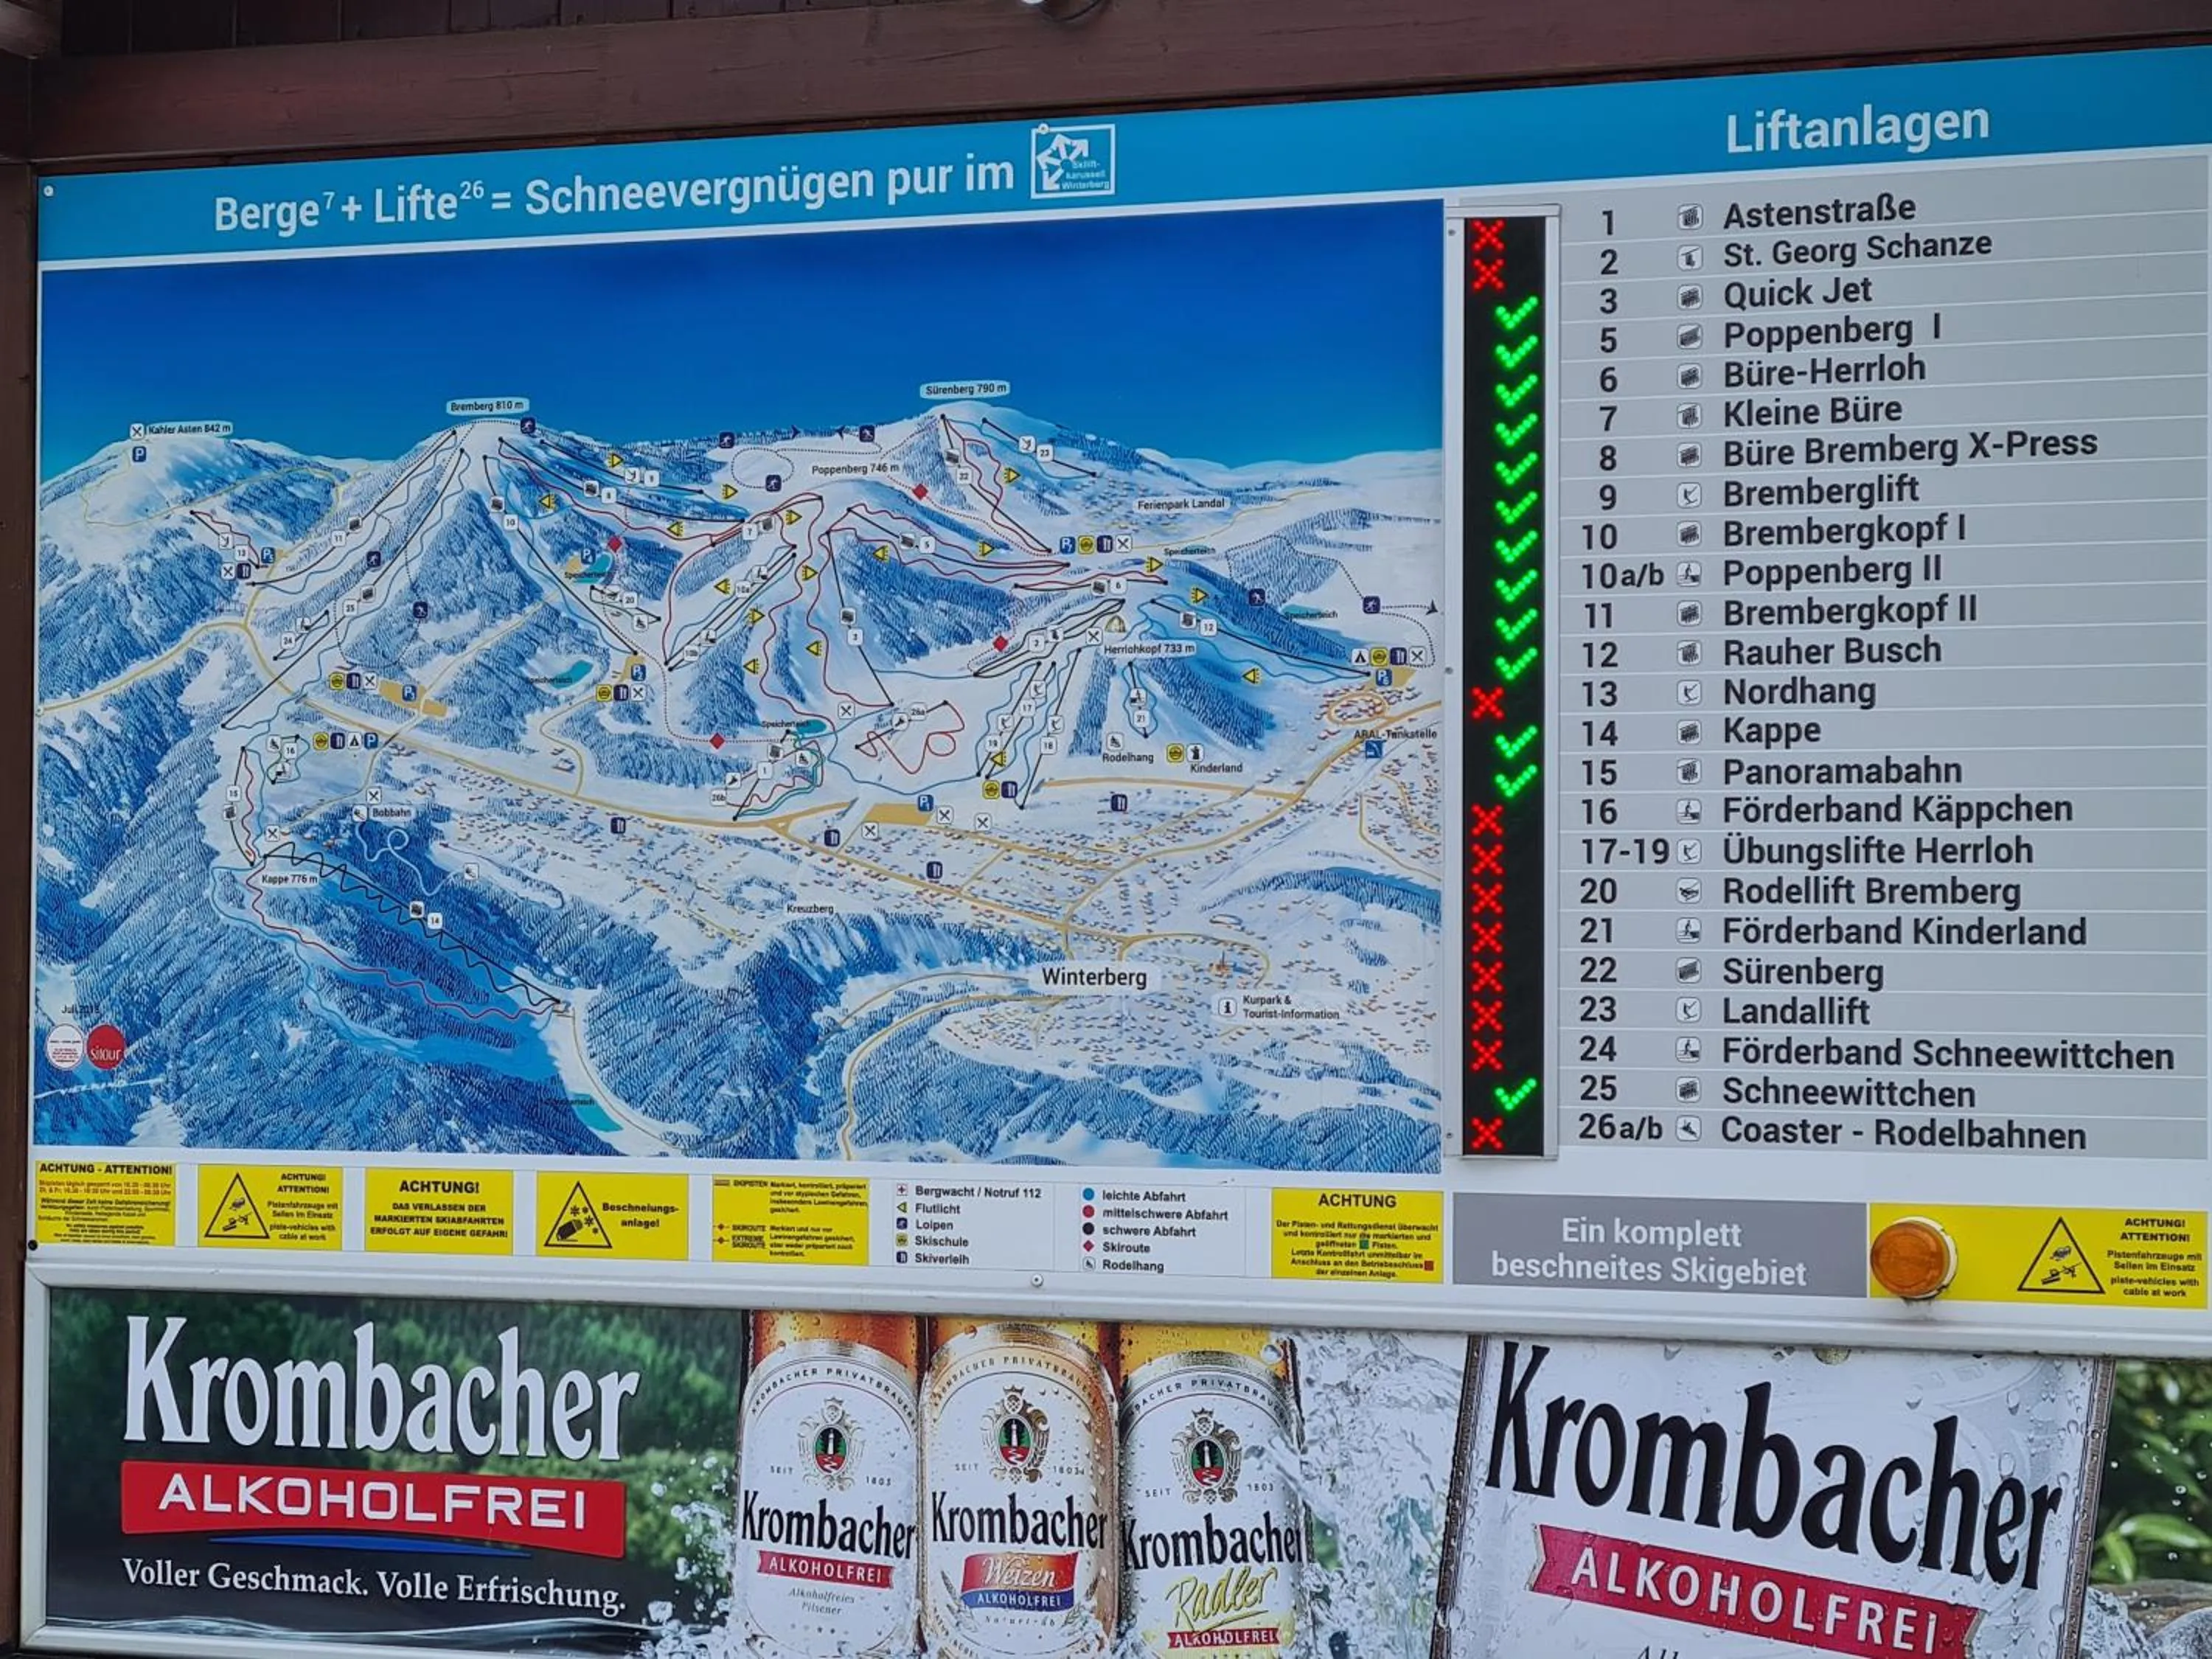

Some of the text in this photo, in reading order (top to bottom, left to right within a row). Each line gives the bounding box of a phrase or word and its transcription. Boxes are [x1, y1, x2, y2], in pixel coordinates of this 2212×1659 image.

[1727, 104, 1990, 153] Liftanlagen
[526, 166, 873, 215] Schneevergnügen
[888, 164, 953, 205] pur
[966, 153, 1015, 192] im
[1601, 192, 1917, 237] 1 Astenstraße
[1599, 231, 1993, 276] 2 St. Georg Schanze
[1599, 276, 1874, 316] 3 Quick Jet
[1599, 312, 1942, 355] 5 Poppenberg I
[1599, 353, 1927, 394] 6 Büre-Herrloh
[926, 385, 973, 395] Sürenberg
[978, 383, 994, 393] 790
[451, 401, 493, 411] Bremberg
[495, 400, 512, 410] 810
[1599, 395, 1903, 433] 7 Kleine Büre
[149, 423, 230, 434] Kahler Asten 842 m
[1598, 427, 2098, 473] 8 Büre Bremberg X-Press
[812, 465, 867, 476] Poppenberg
[870, 463, 888, 472] 746
[1138, 498, 1225, 510] Ferienpark Landal
[1599, 473, 1920, 512] 9 Bremberglift
[1581, 512, 1966, 552] 10 Brembergkopf I
[1723, 557, 1913, 591] Poppenberg
[1921, 554, 1942, 582] II
[1583, 593, 1978, 630] 11 Brembergkopf II
[1105, 645, 1162, 655] Herrlohkopf
[1164, 644, 1182, 653] 733
[1582, 634, 1942, 669] 12 Rauher Busch
[1582, 676, 1877, 710] 13 Nordhang
[1582, 717, 1821, 750] 14 Kappe
[1103, 752, 1154, 764] Rodelhang
[1191, 762, 1242, 773] Kinderland
[1581, 757, 1963, 787] 15 Panoramabahn
[373, 807, 411, 817] Bobbahn
[1581, 793, 2073, 828] 16 Förderband Käppchen
[1581, 833, 2034, 872] 17-19 Übungslifte Herrloh
[262, 875, 288, 884] Kappe
[291, 874, 307, 883] 776
[1579, 876, 2022, 911] 20 Rodellift Bremberg
[787, 904, 833, 915] Kreuzberg
[1579, 914, 2087, 947] 21 Förderband Kinderland
[1042, 967, 1147, 990] Winterberg
[1579, 956, 1885, 991] 22 Sürenberg
[1243, 995, 1282, 1006] Kurpark
[1243, 1009, 1340, 1019] Tourist-Information
[1579, 995, 1871, 1027] 23 Landallift
[1579, 1034, 2175, 1071] 24 Förderband Schneewittchen
[1579, 1074, 1977, 1109] 25 Schneewittchen
[1721, 1114, 1843, 1148] Coaster
[1874, 1119, 2087, 1151] Rodelbahnen
[40, 1164, 172, 1175] ACHTUNG ATTENTION!
[400, 1180, 479, 1194] ACHTUNG!
[915, 1186, 1041, 1199] Bergwacht Notruf 112
[1103, 1190, 1185, 1202] leichte Abfahrt
[1318, 1194, 1396, 1208] ACHTUNG
[375, 1215, 432, 1224] MARKIERTEN
[412, 1203, 465, 1211] VERLASSEN
[602, 1203, 678, 1215] Beschneiungs-
[915, 1203, 960, 1214] Flutlicht
[1103, 1208, 1228, 1220] mittelschwere Abfahrt
[371, 1227, 410, 1236] ERFOLGT
[621, 1218, 660, 1228] anlage!
[916, 1220, 953, 1231] Loipen
[1103, 1226, 1196, 1237] schwere Abfahrt
[1562, 1217, 1742, 1251] Ein komplett
[2121, 1233, 2190, 1242] ATTENTION!
[2125, 1218, 2185, 1228] ACHTUNG!
[915, 1237, 968, 1248] Skischule
[1103, 1242, 1150, 1253] Skiroute
[915, 1253, 969, 1265] Skiverleih
[1103, 1261, 1164, 1273] Rodelhang
[1492, 1251, 1806, 1290] beschneites Skigebiet
[123, 1315, 640, 1461] Krombacher
[1485, 1340, 2064, 1590] Krombacher
[159, 1472, 585, 1529] ALKOHOLFREI
[742, 1489, 917, 1559] Krombacher
[932, 1491, 1107, 1548] Krombacher
[769, 1557, 881, 1582] ALKOHOLFREI
[983, 1556, 1057, 1587] Weizen
[122, 1558, 626, 1617] Voller Geschmack. Volle Erfrischung.
[978, 1592, 1061, 1607] ALKOHOLFREI
[1166, 1566, 1278, 1632] Radler
[1571, 1545, 1938, 1655] ALKOHOLFREI
